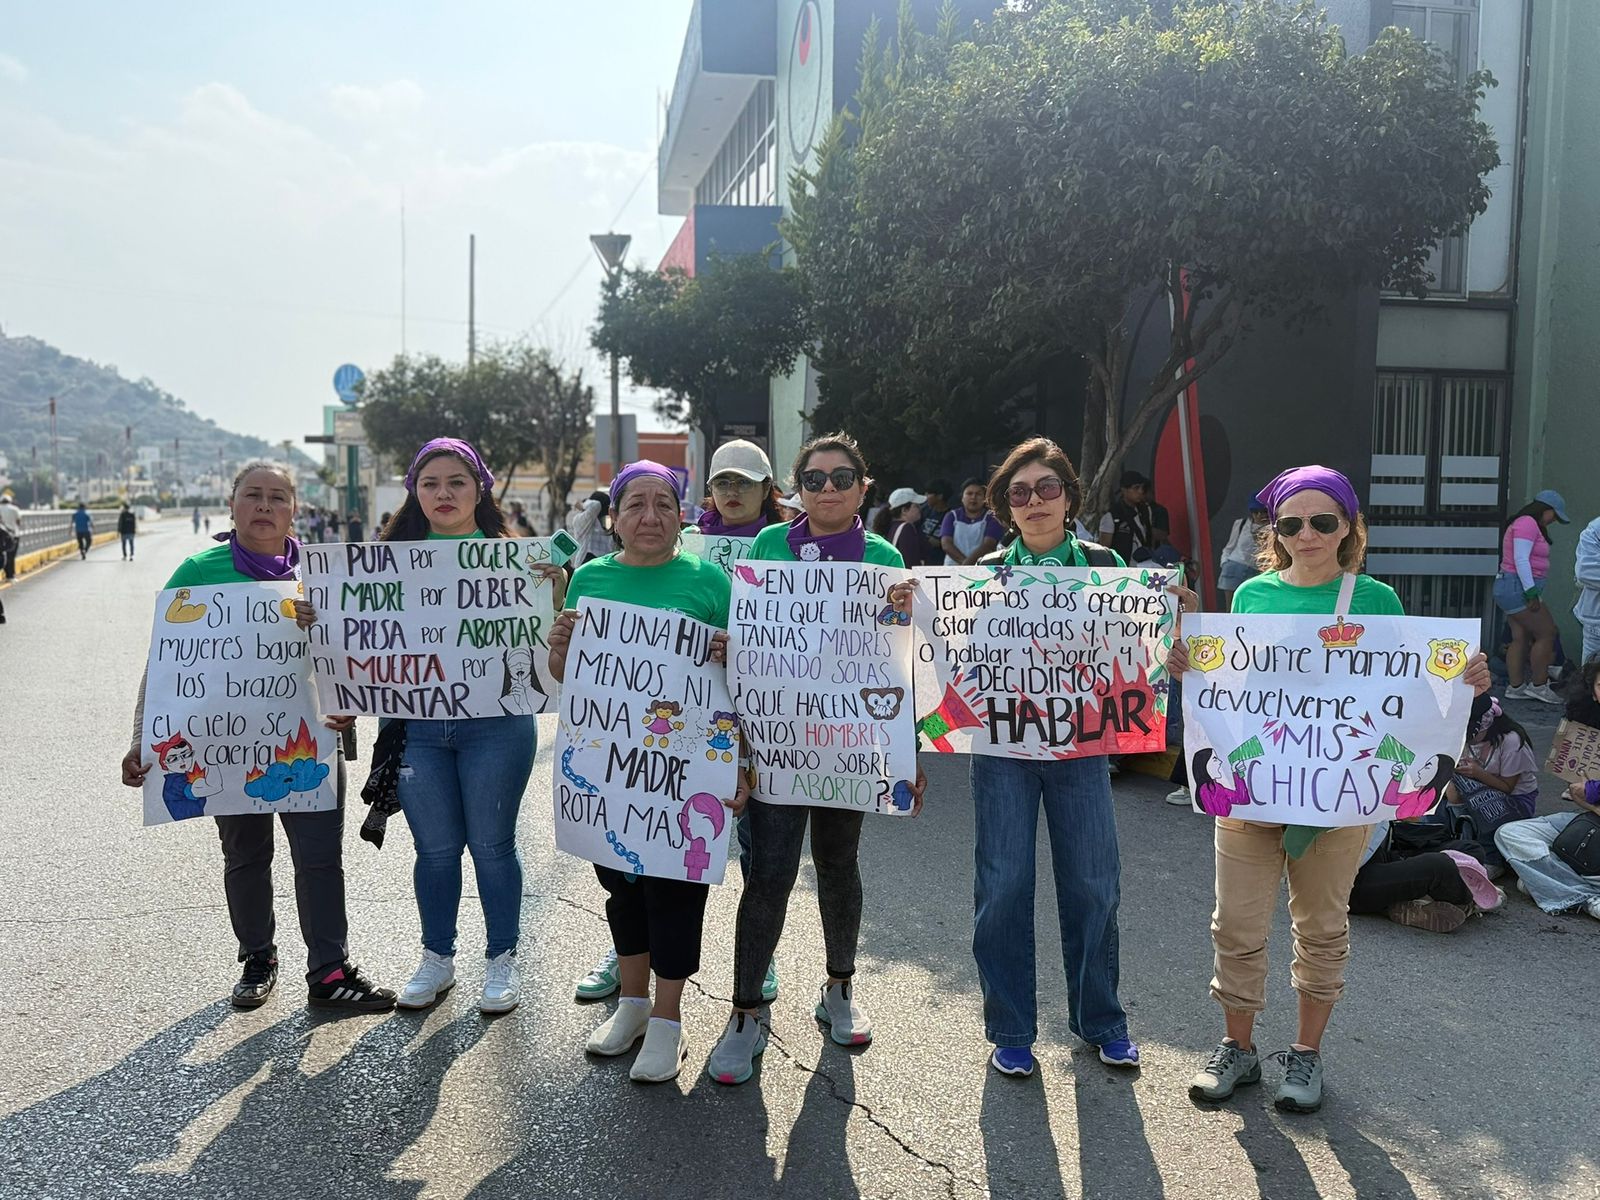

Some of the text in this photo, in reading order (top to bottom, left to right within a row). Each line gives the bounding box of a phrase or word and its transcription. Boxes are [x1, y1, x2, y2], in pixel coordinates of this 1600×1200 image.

[306, 540, 523, 576] ni PUTA por COGER
[308, 577, 532, 612] ni MADRE por DEBER
[765, 567, 889, 599] EN UN PAÍS
[1042, 585, 1077, 612] dos
[207, 592, 280, 629] Si las
[736, 599, 878, 632] EN EL QUE HAY
[308, 615, 551, 650] ni PRESA por ABORTAR
[581, 606, 713, 668] NI UNA HIJ
[737, 623, 893, 658] TANTAS MADRES
[931, 614, 1166, 649] estar calladas y morir
[158, 635, 243, 667] mujeres
[945, 641, 1013, 667] hablar
[1022, 647, 1034, 667] y
[1043, 646, 1103, 666] morir
[1120, 646, 1133, 666] y
[1200, 650, 1209, 660] G
[1325, 644, 1421, 679] mamón
[1443, 652, 1455, 666] G
[176, 672, 298, 699] los brazos
[313, 653, 494, 685] ni MUERTA por
[736, 650, 891, 688] CRIANDO SOLAS
[977, 661, 1112, 697] DECIDIMOS
[684, 675, 712, 710] NI
[796, 692, 859, 720] HACEN
[1198, 681, 1404, 720] devuelveme a
[152, 711, 292, 739] el cielo se
[570, 695, 631, 739] UNA
[805, 721, 891, 748] HOMBRES
[984, 688, 1154, 748] HABLAR
[203, 740, 272, 766] caería
[1280, 722, 1350, 762] MIS
[605, 742, 690, 802] MADRE
[834, 752, 896, 779] SOBRE
[758, 772, 779, 796] EL
[1246, 759, 1381, 816] CHICAS
[560, 785, 609, 831] ROTA
